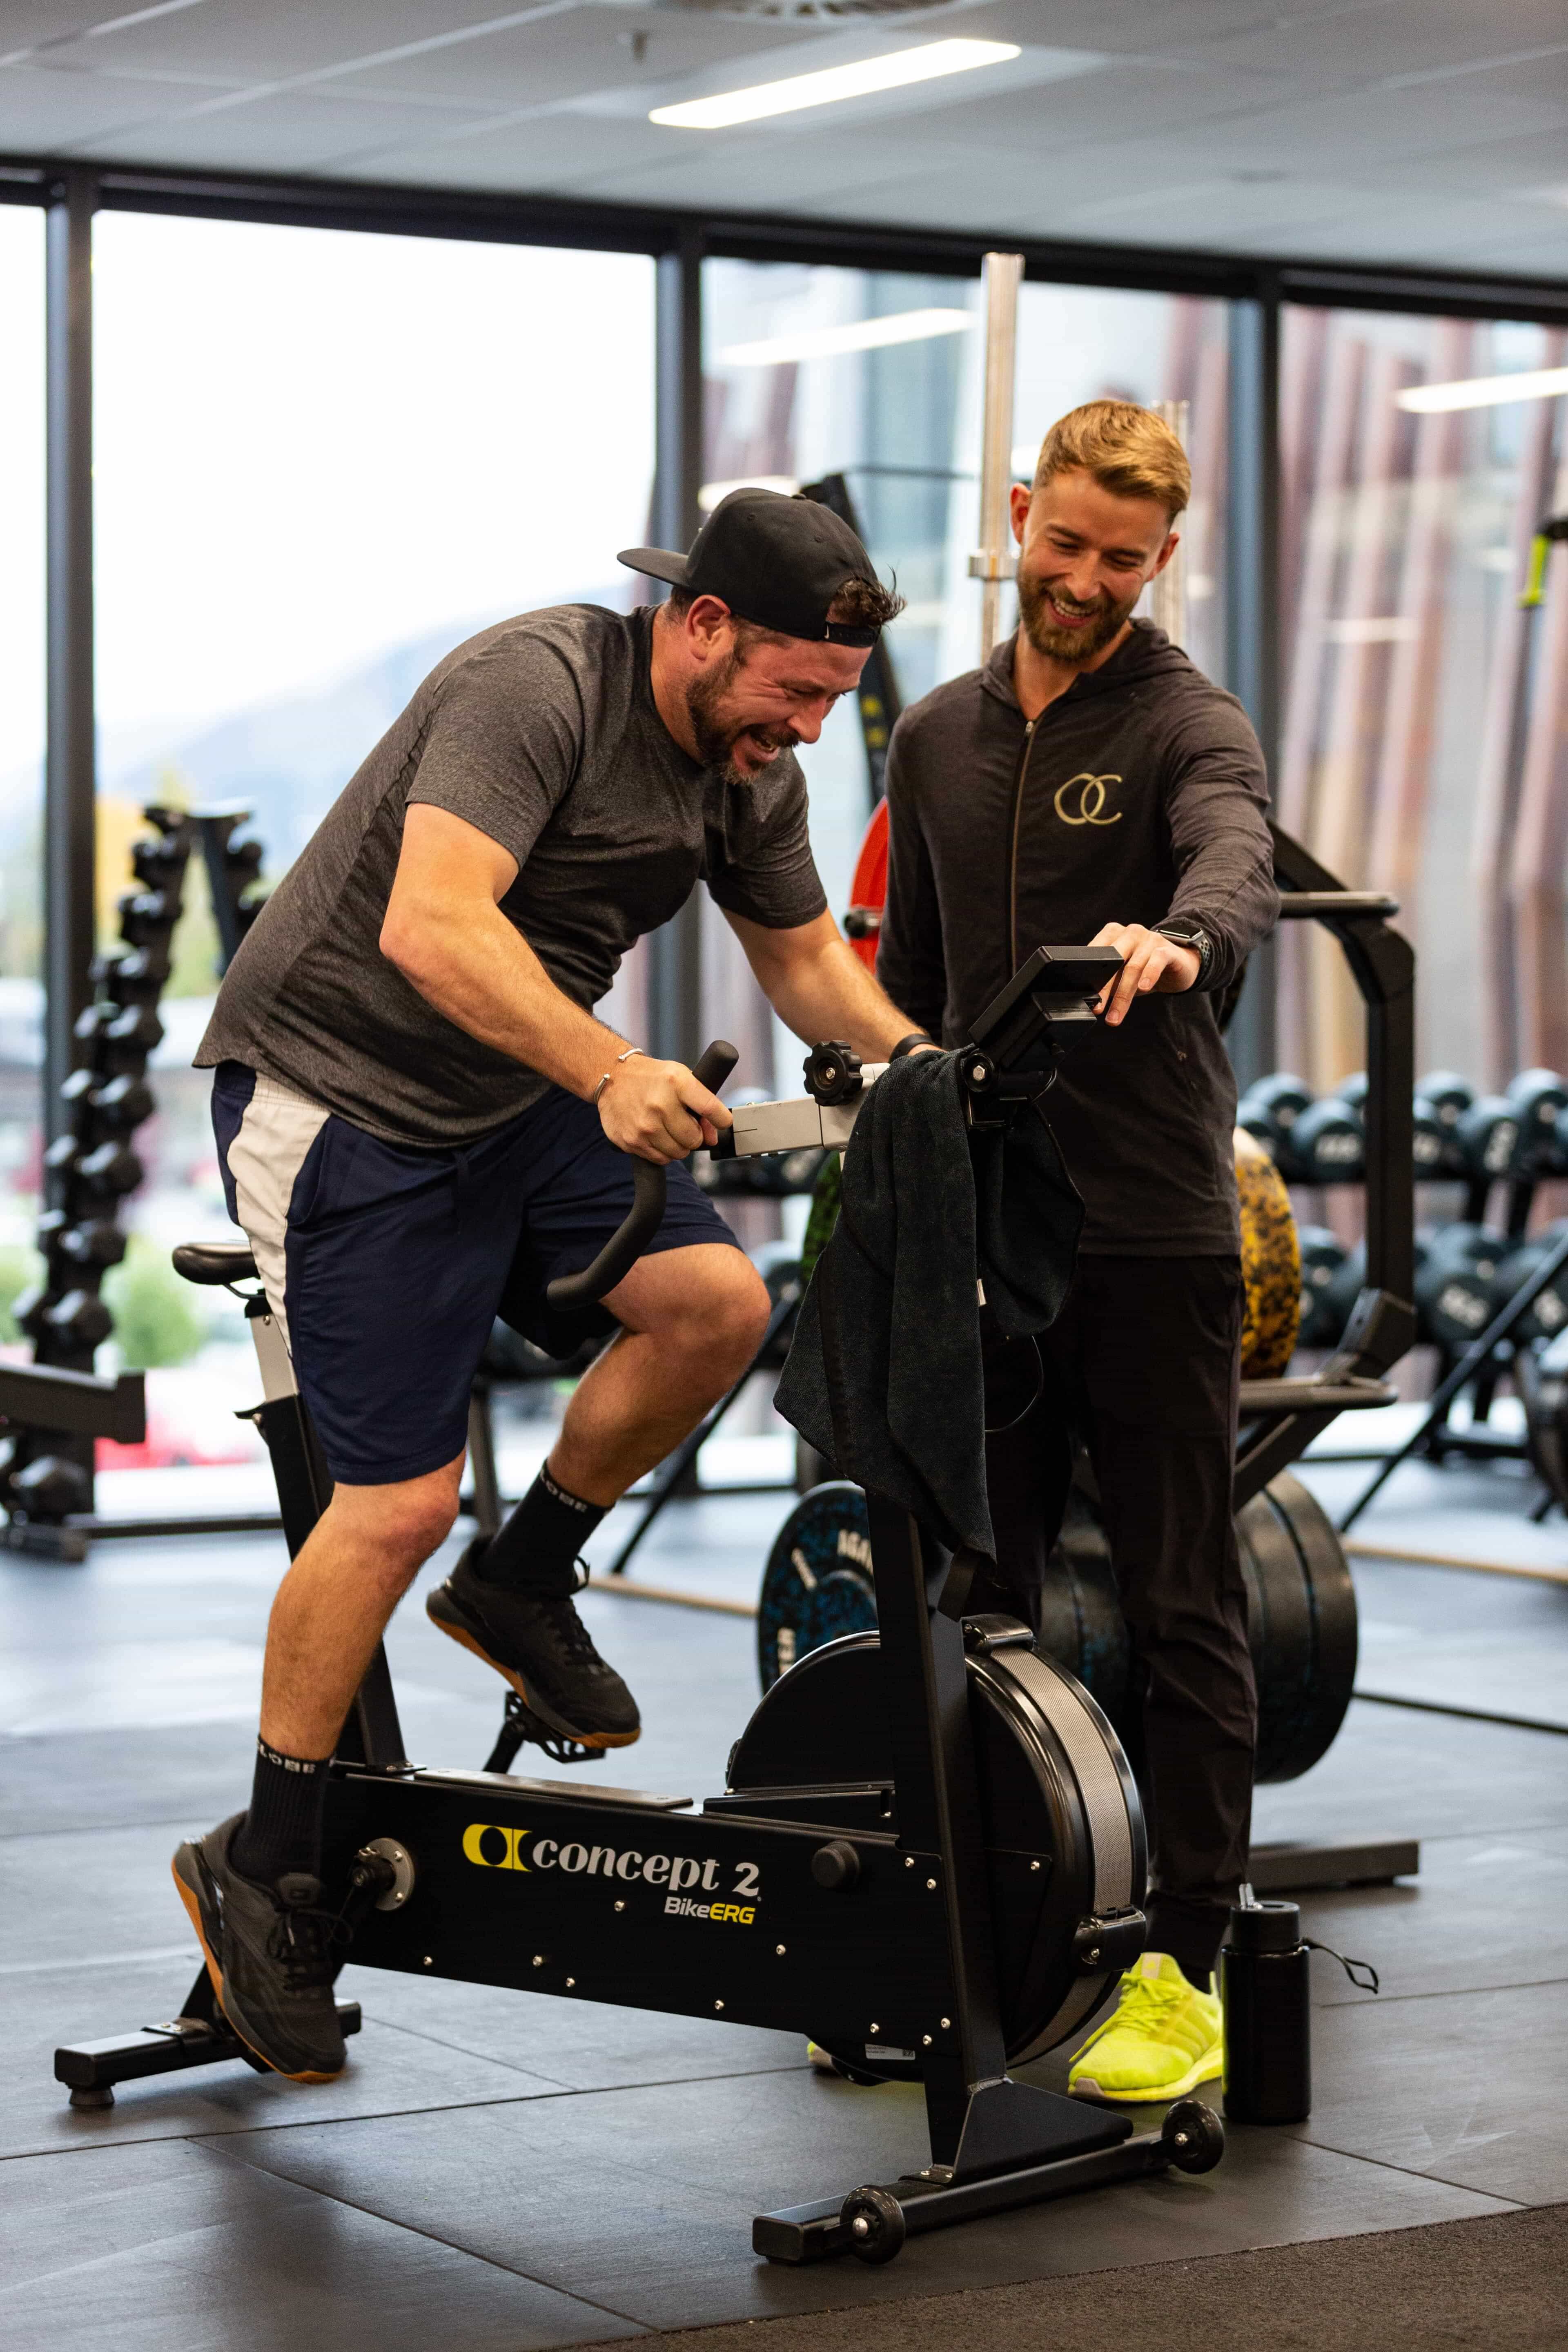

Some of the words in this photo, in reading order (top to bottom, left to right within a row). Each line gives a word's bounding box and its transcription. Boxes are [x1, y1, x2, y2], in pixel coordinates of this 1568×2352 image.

[532, 1840, 720, 1891] concept
[732, 1862, 759, 1897] 2
[664, 1896, 755, 1924] BikeERG
